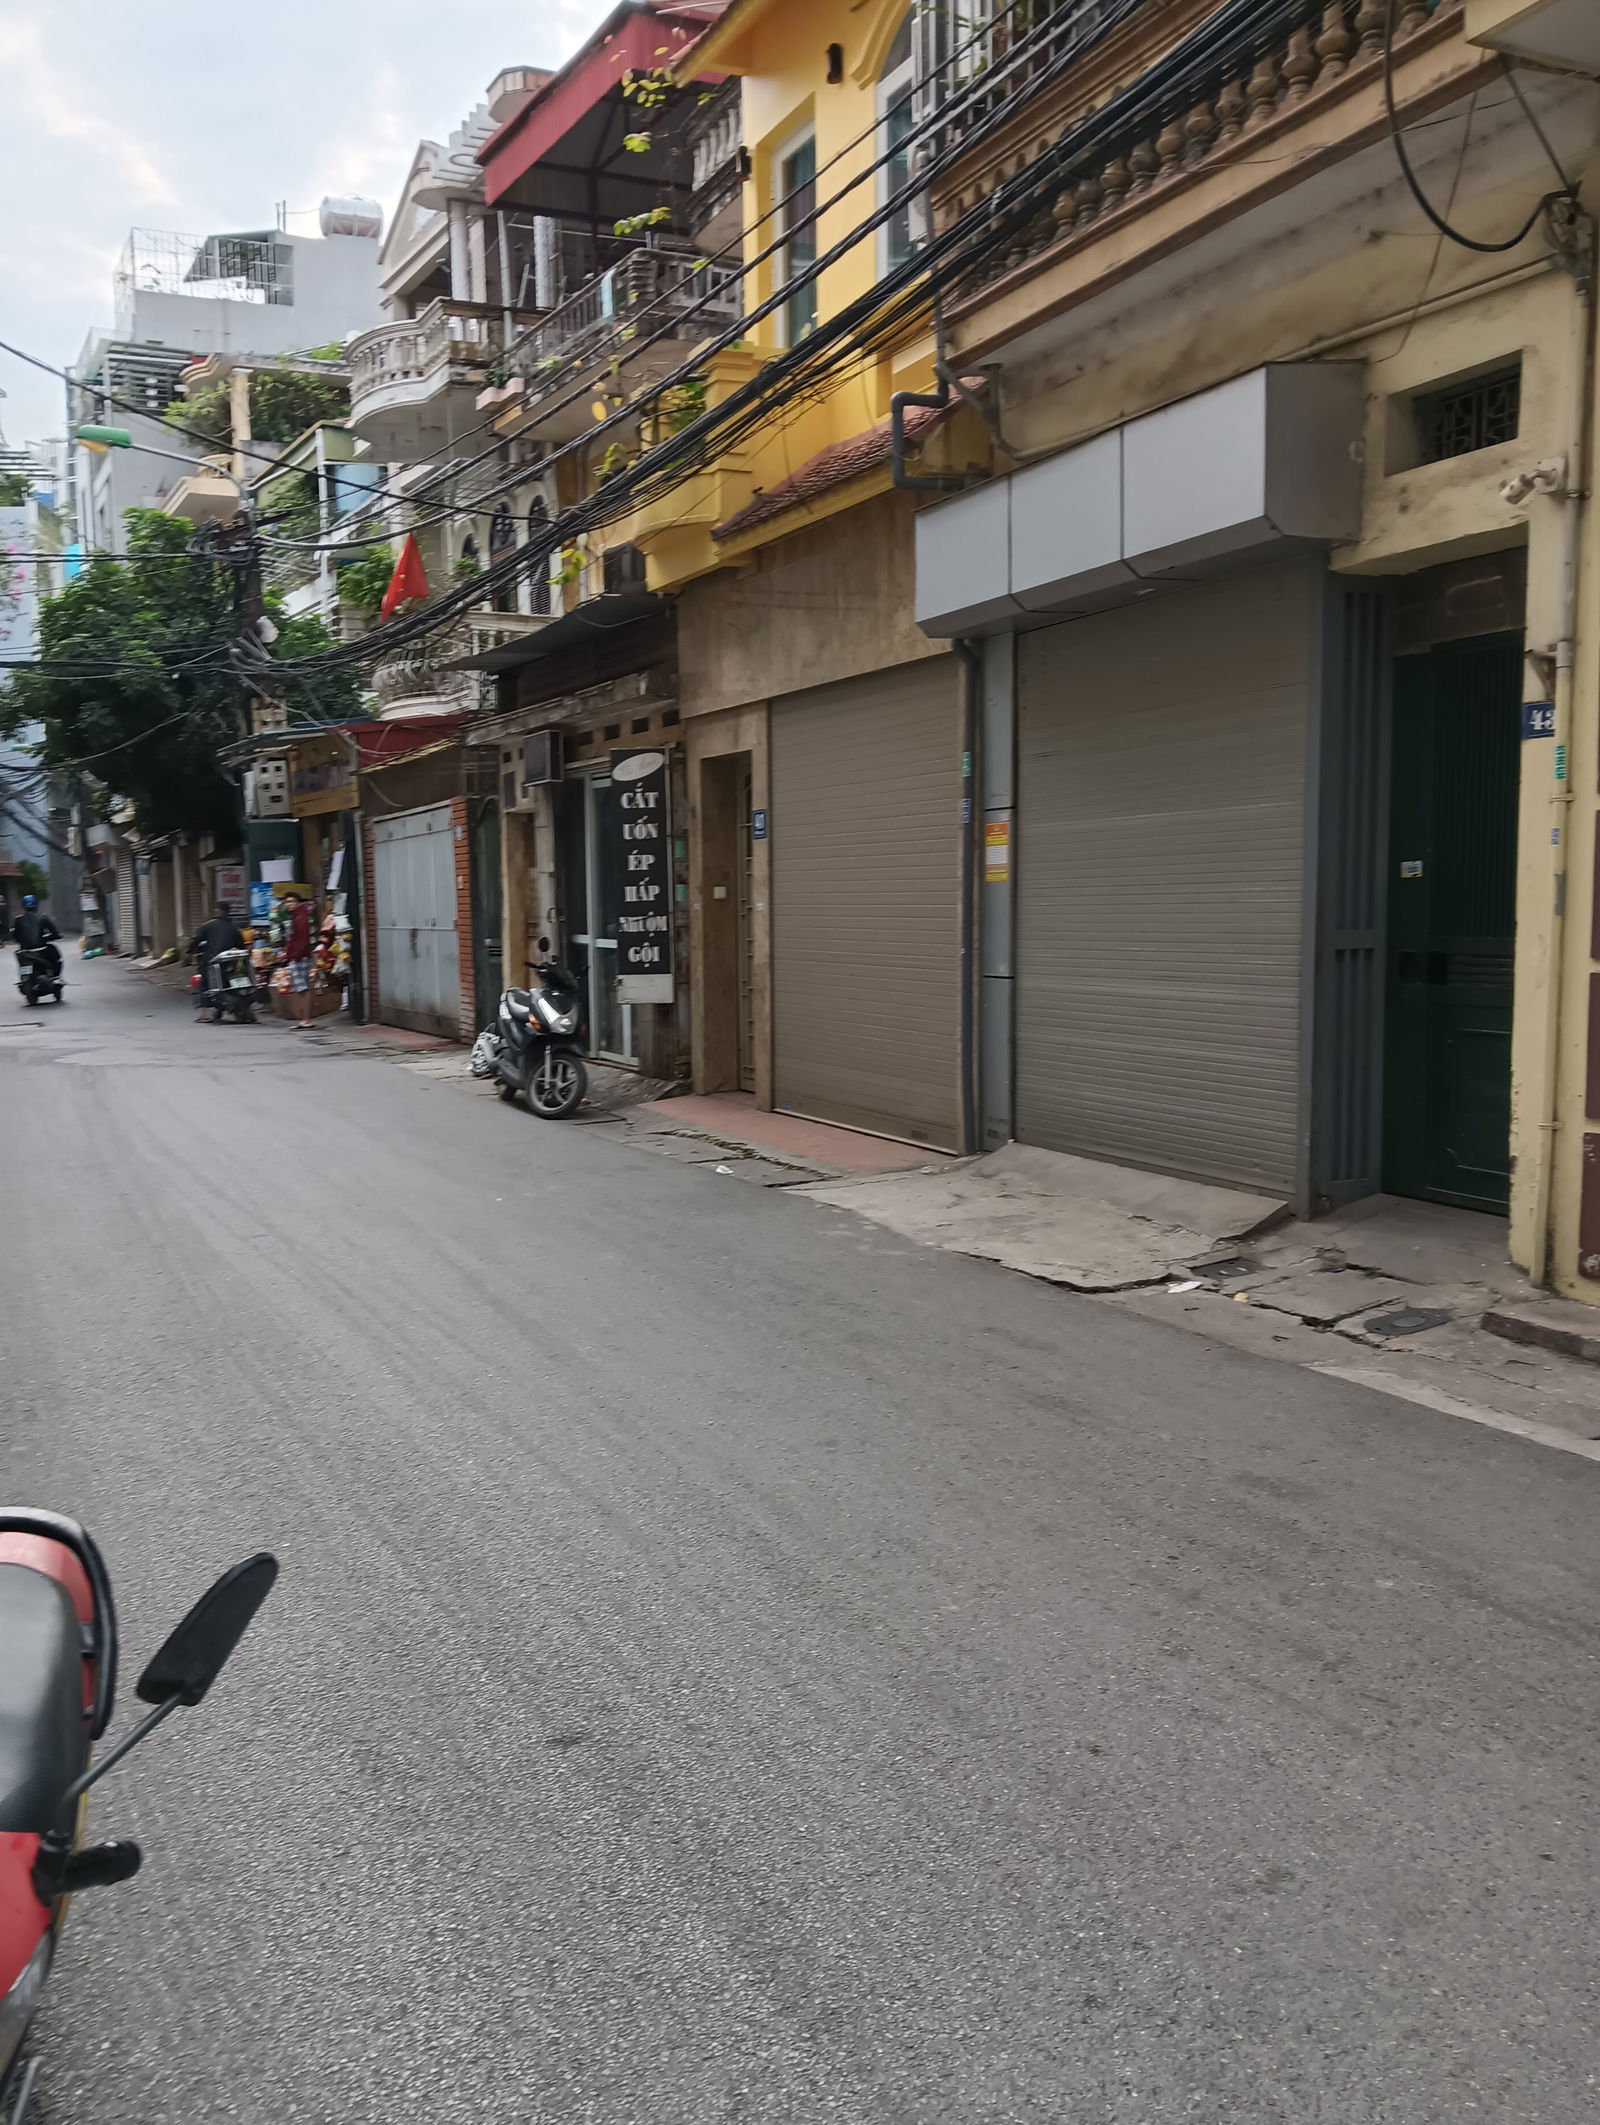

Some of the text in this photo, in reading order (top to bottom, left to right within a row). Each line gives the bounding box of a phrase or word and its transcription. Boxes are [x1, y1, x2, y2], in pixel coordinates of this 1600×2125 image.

[620, 782, 659, 809] CẮT
[622, 816, 659, 840] UỐN
[627, 849, 656, 871] ÉP
[624, 877, 661, 902] HẤP
[628, 942, 661, 968] GỘI
